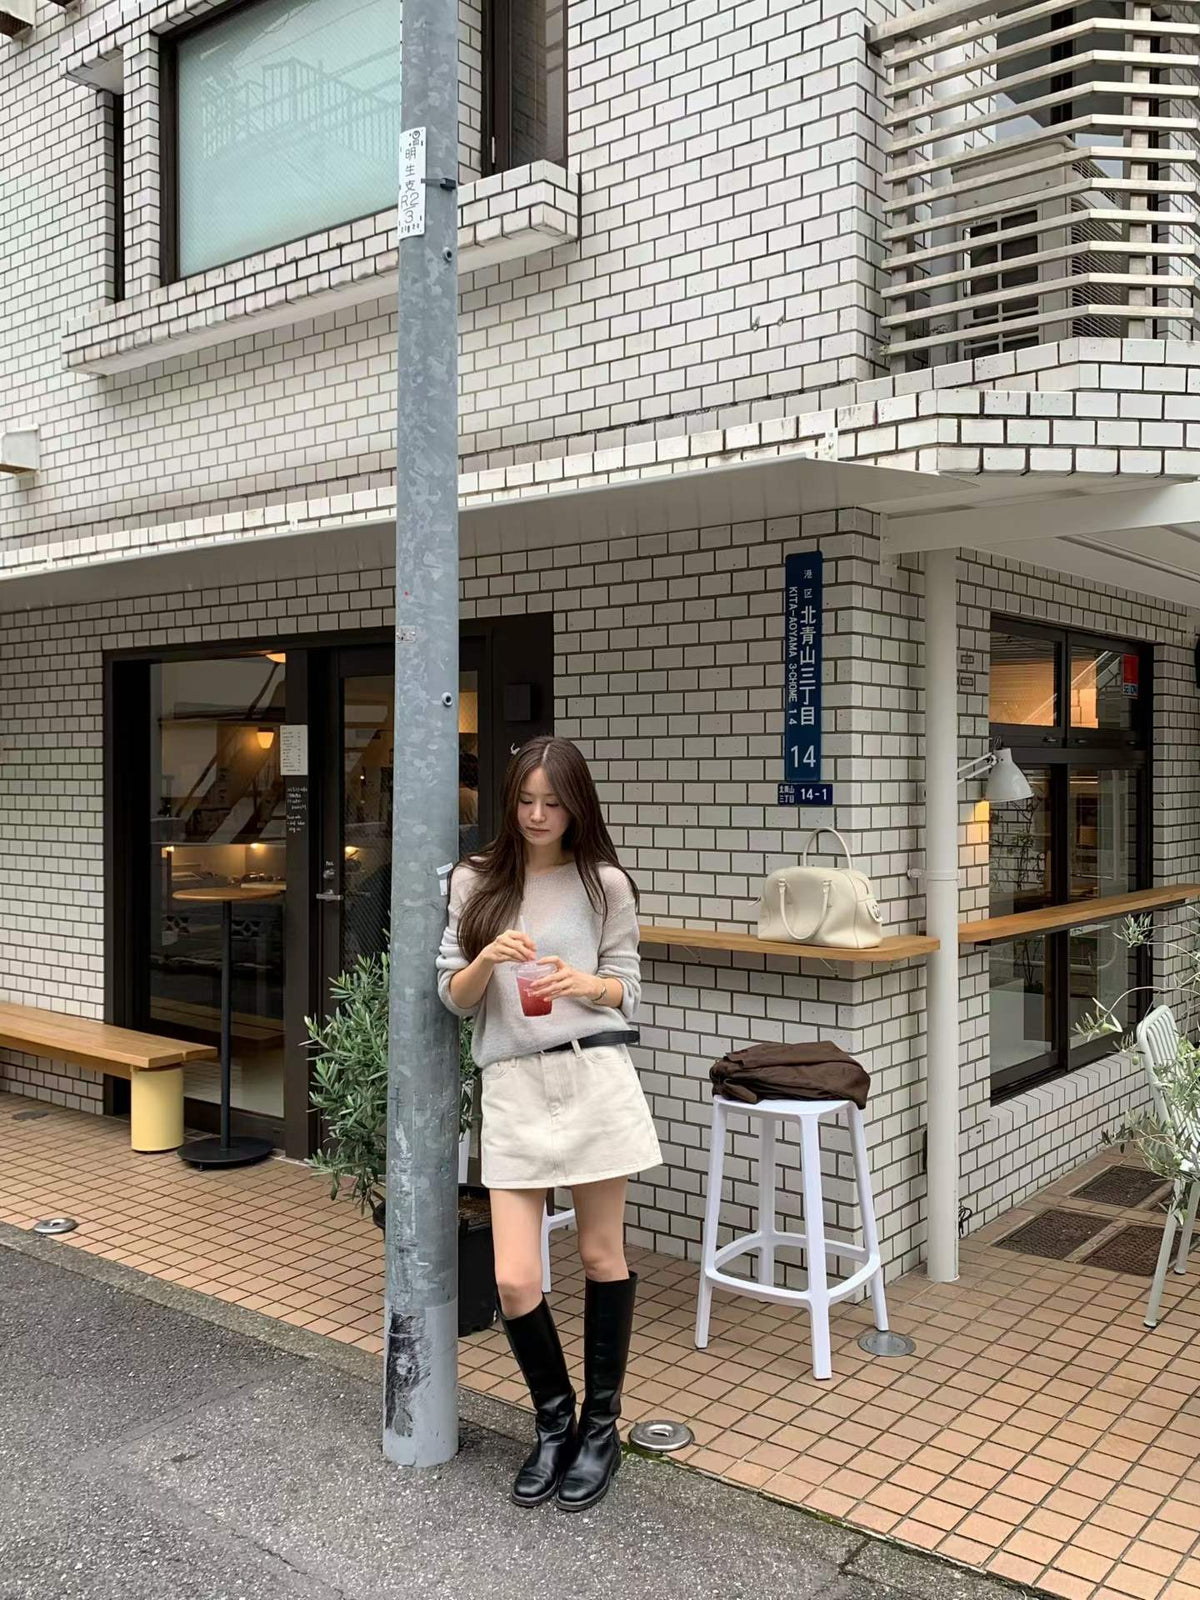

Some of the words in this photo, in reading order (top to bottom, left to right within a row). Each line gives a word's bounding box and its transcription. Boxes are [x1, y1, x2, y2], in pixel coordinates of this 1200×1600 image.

[788, 586, 798, 658] KITA-AOYAMA
[800, 605, 816, 726] 北青山三丁目
[790, 745, 816, 768] 14
[800, 788, 827, 801] 14-1
